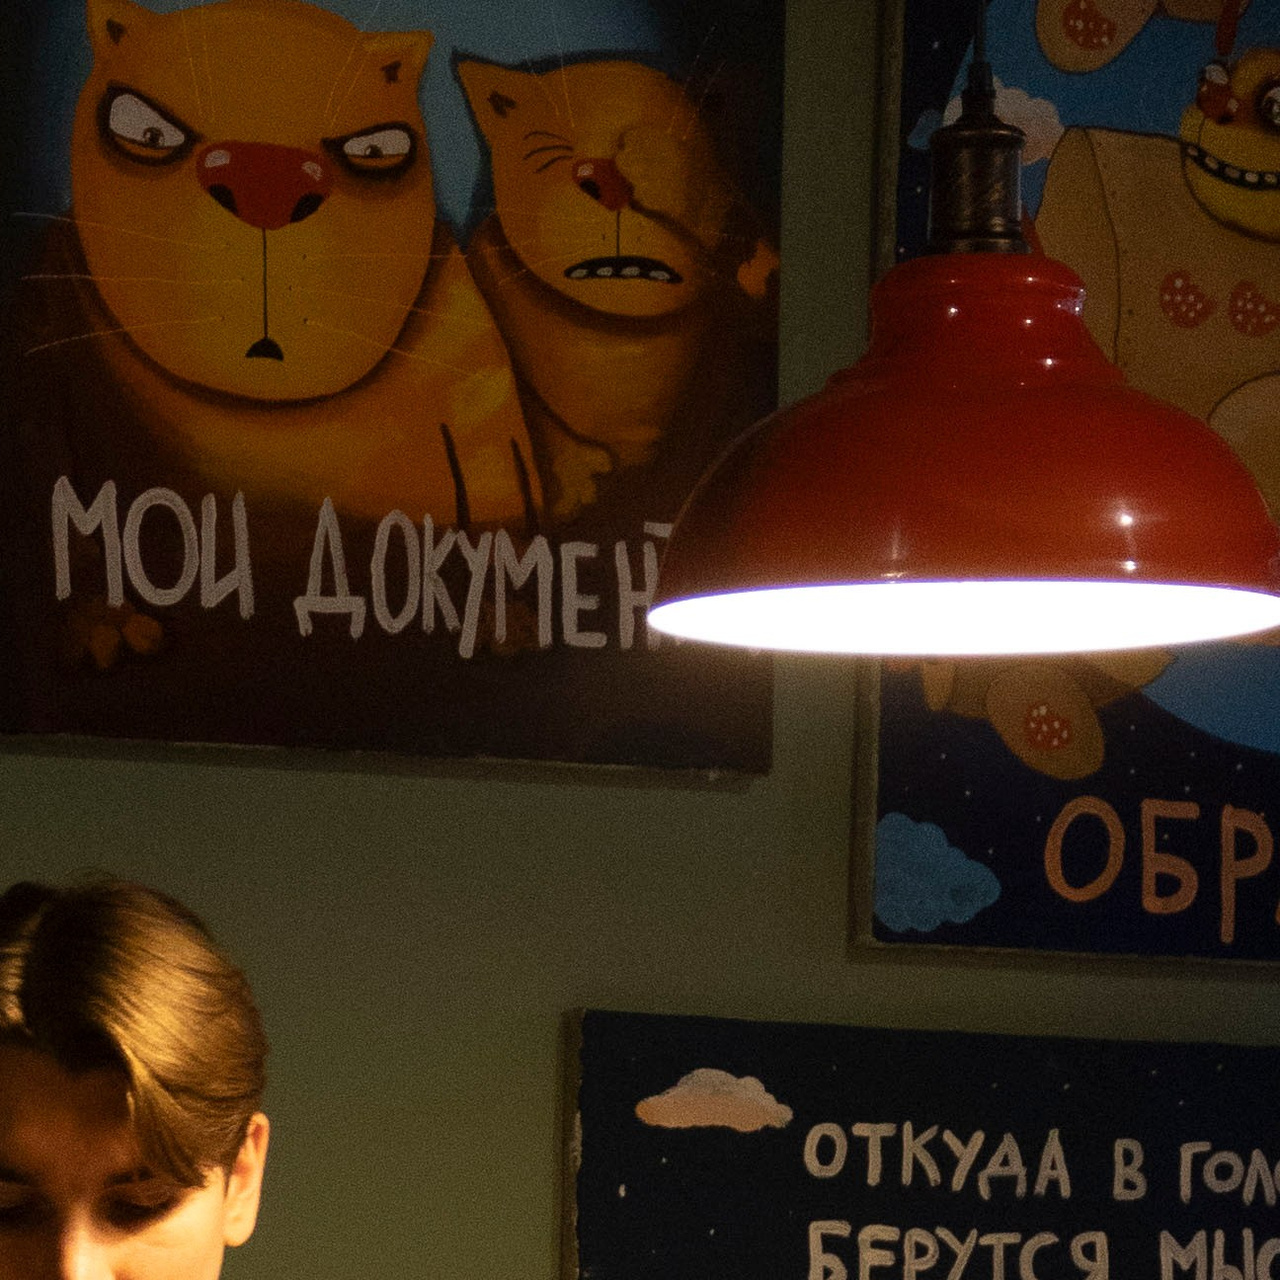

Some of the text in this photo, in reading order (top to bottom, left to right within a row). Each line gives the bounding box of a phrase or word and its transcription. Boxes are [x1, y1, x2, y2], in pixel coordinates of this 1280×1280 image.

[51, 474, 675, 660] МОИ ДОКУМЕН
[1043, 794, 1280, 945] ОБР
[802, 1120, 1280, 1207] ОТКУДА В ГОЛ
